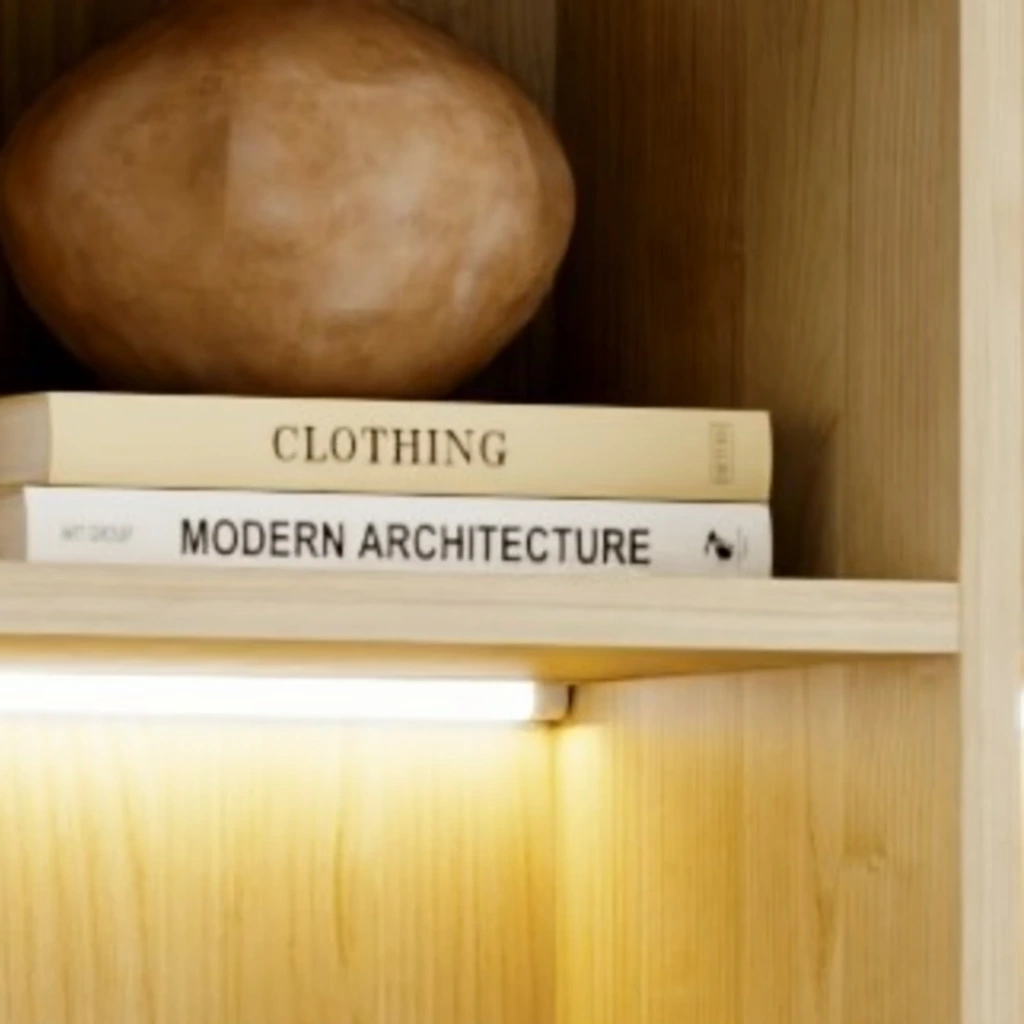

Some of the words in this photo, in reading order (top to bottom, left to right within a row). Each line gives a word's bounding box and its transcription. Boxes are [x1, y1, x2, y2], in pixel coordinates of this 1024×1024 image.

[271, 424, 509, 467] CLOTHING
[180, 518, 345, 558] MODERN
[358, 521, 651, 565] ARCHITECTURE
